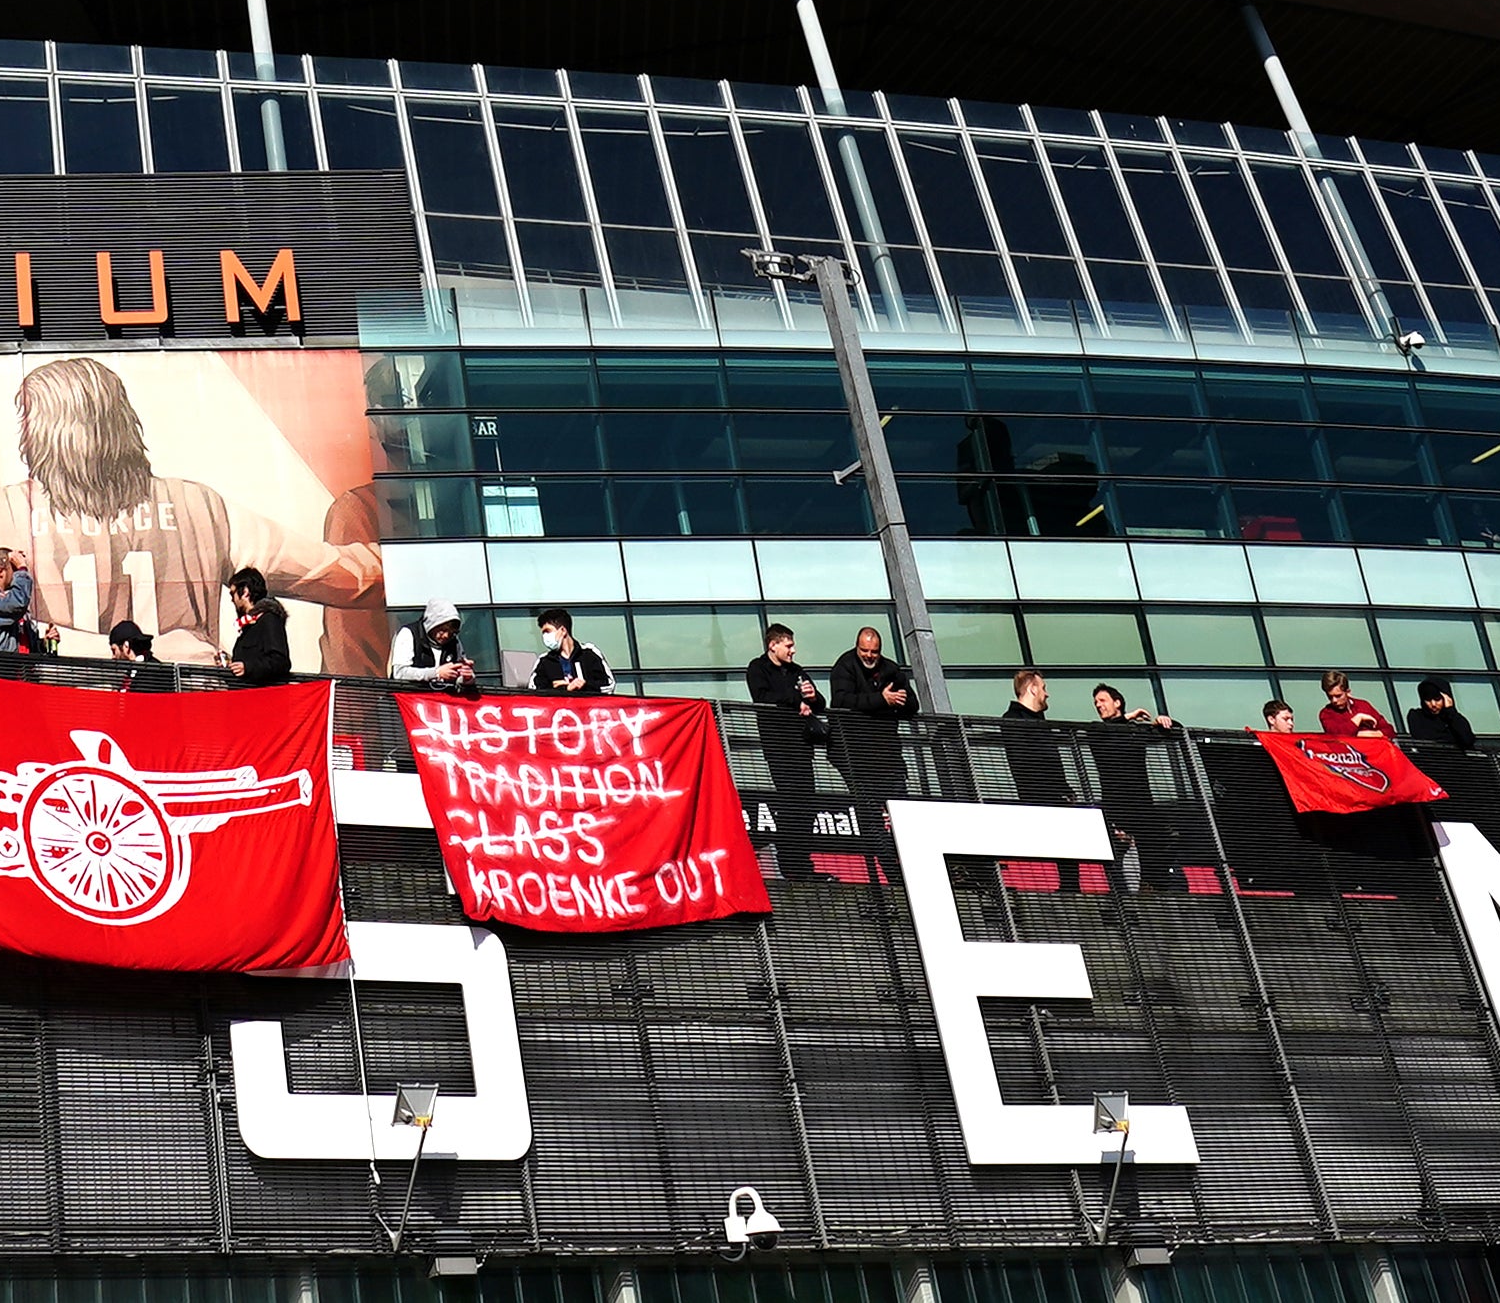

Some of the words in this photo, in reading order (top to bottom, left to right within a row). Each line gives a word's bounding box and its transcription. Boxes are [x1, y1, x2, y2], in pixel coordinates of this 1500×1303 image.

[63, 550, 160, 638] 11
[414, 703, 655, 757] HISTORY
[430, 748, 668, 809] TRADITION
[446, 809, 606, 866] CLASS
[465, 858, 647, 919] KROENKE
[653, 848, 730, 906] OUT
